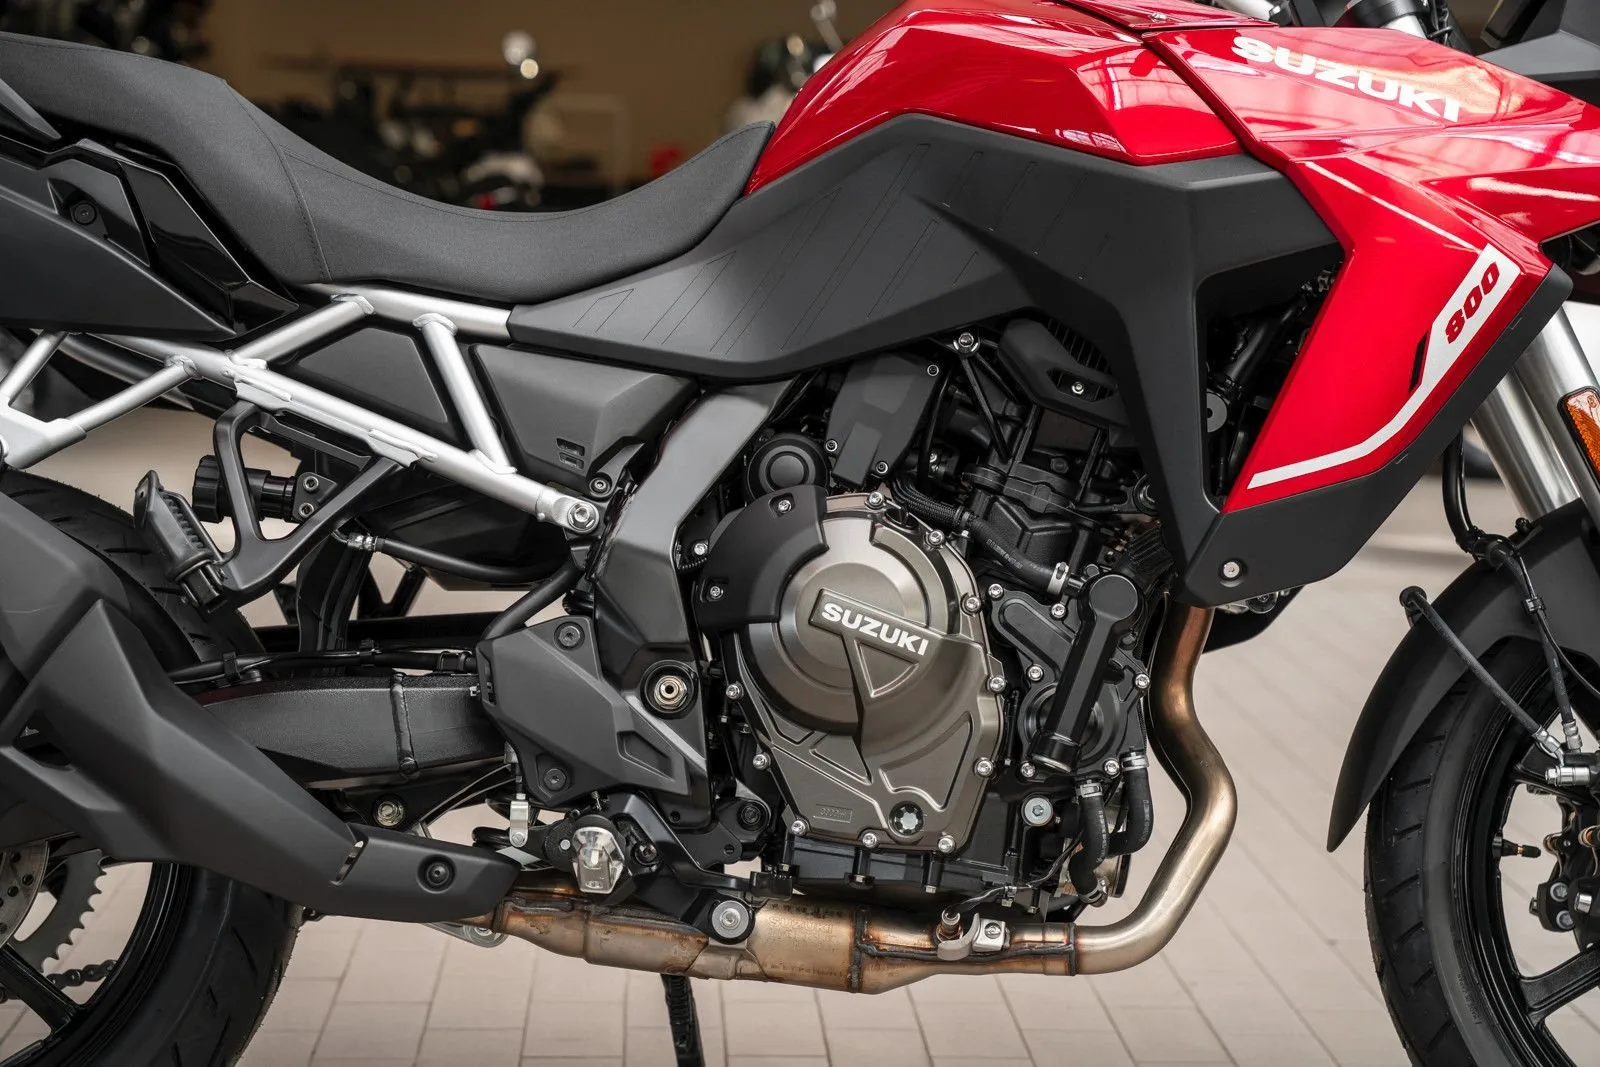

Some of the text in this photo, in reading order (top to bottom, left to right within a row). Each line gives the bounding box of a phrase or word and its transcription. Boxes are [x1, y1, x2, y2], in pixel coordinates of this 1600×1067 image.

[1232, 35, 1460, 122] SUZUKI
[1445, 261, 1500, 343] 800
[821, 602, 929, 656] SUZUKI
